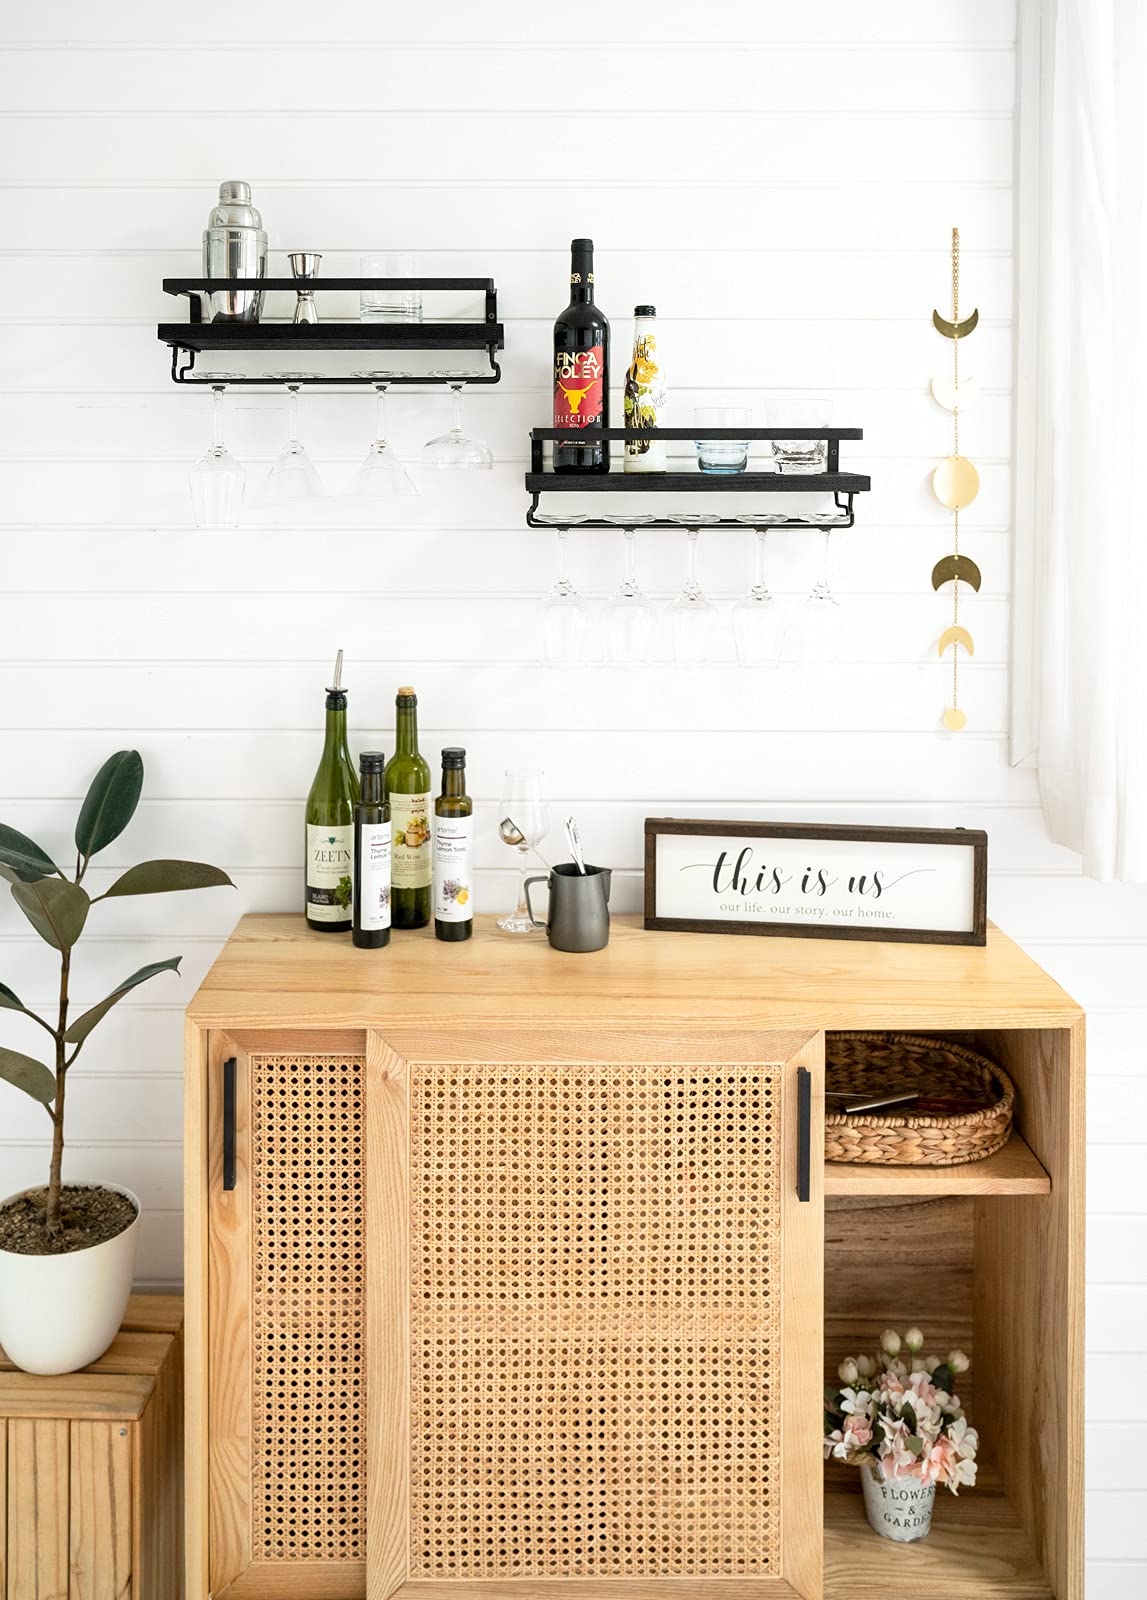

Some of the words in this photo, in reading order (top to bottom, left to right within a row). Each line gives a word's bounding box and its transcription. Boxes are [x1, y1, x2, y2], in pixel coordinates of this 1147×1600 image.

[556, 351, 598, 366] FINCA
[554, 365, 601, 379] MOLEY
[554, 414, 601, 423] SELECTION
[370, 847, 388, 855] Thyme
[680, 847, 792, 896] this
[801, 866, 839, 897] is
[719, 904, 741, 913] our
[744, 901, 766, 913] life.
[770, 905, 791, 915] our
[795, 906, 829, 919] story.
[832, 908, 855, 917] our
[858, 907, 896, 919] home.
[908, 1506, 916, 1515] &
